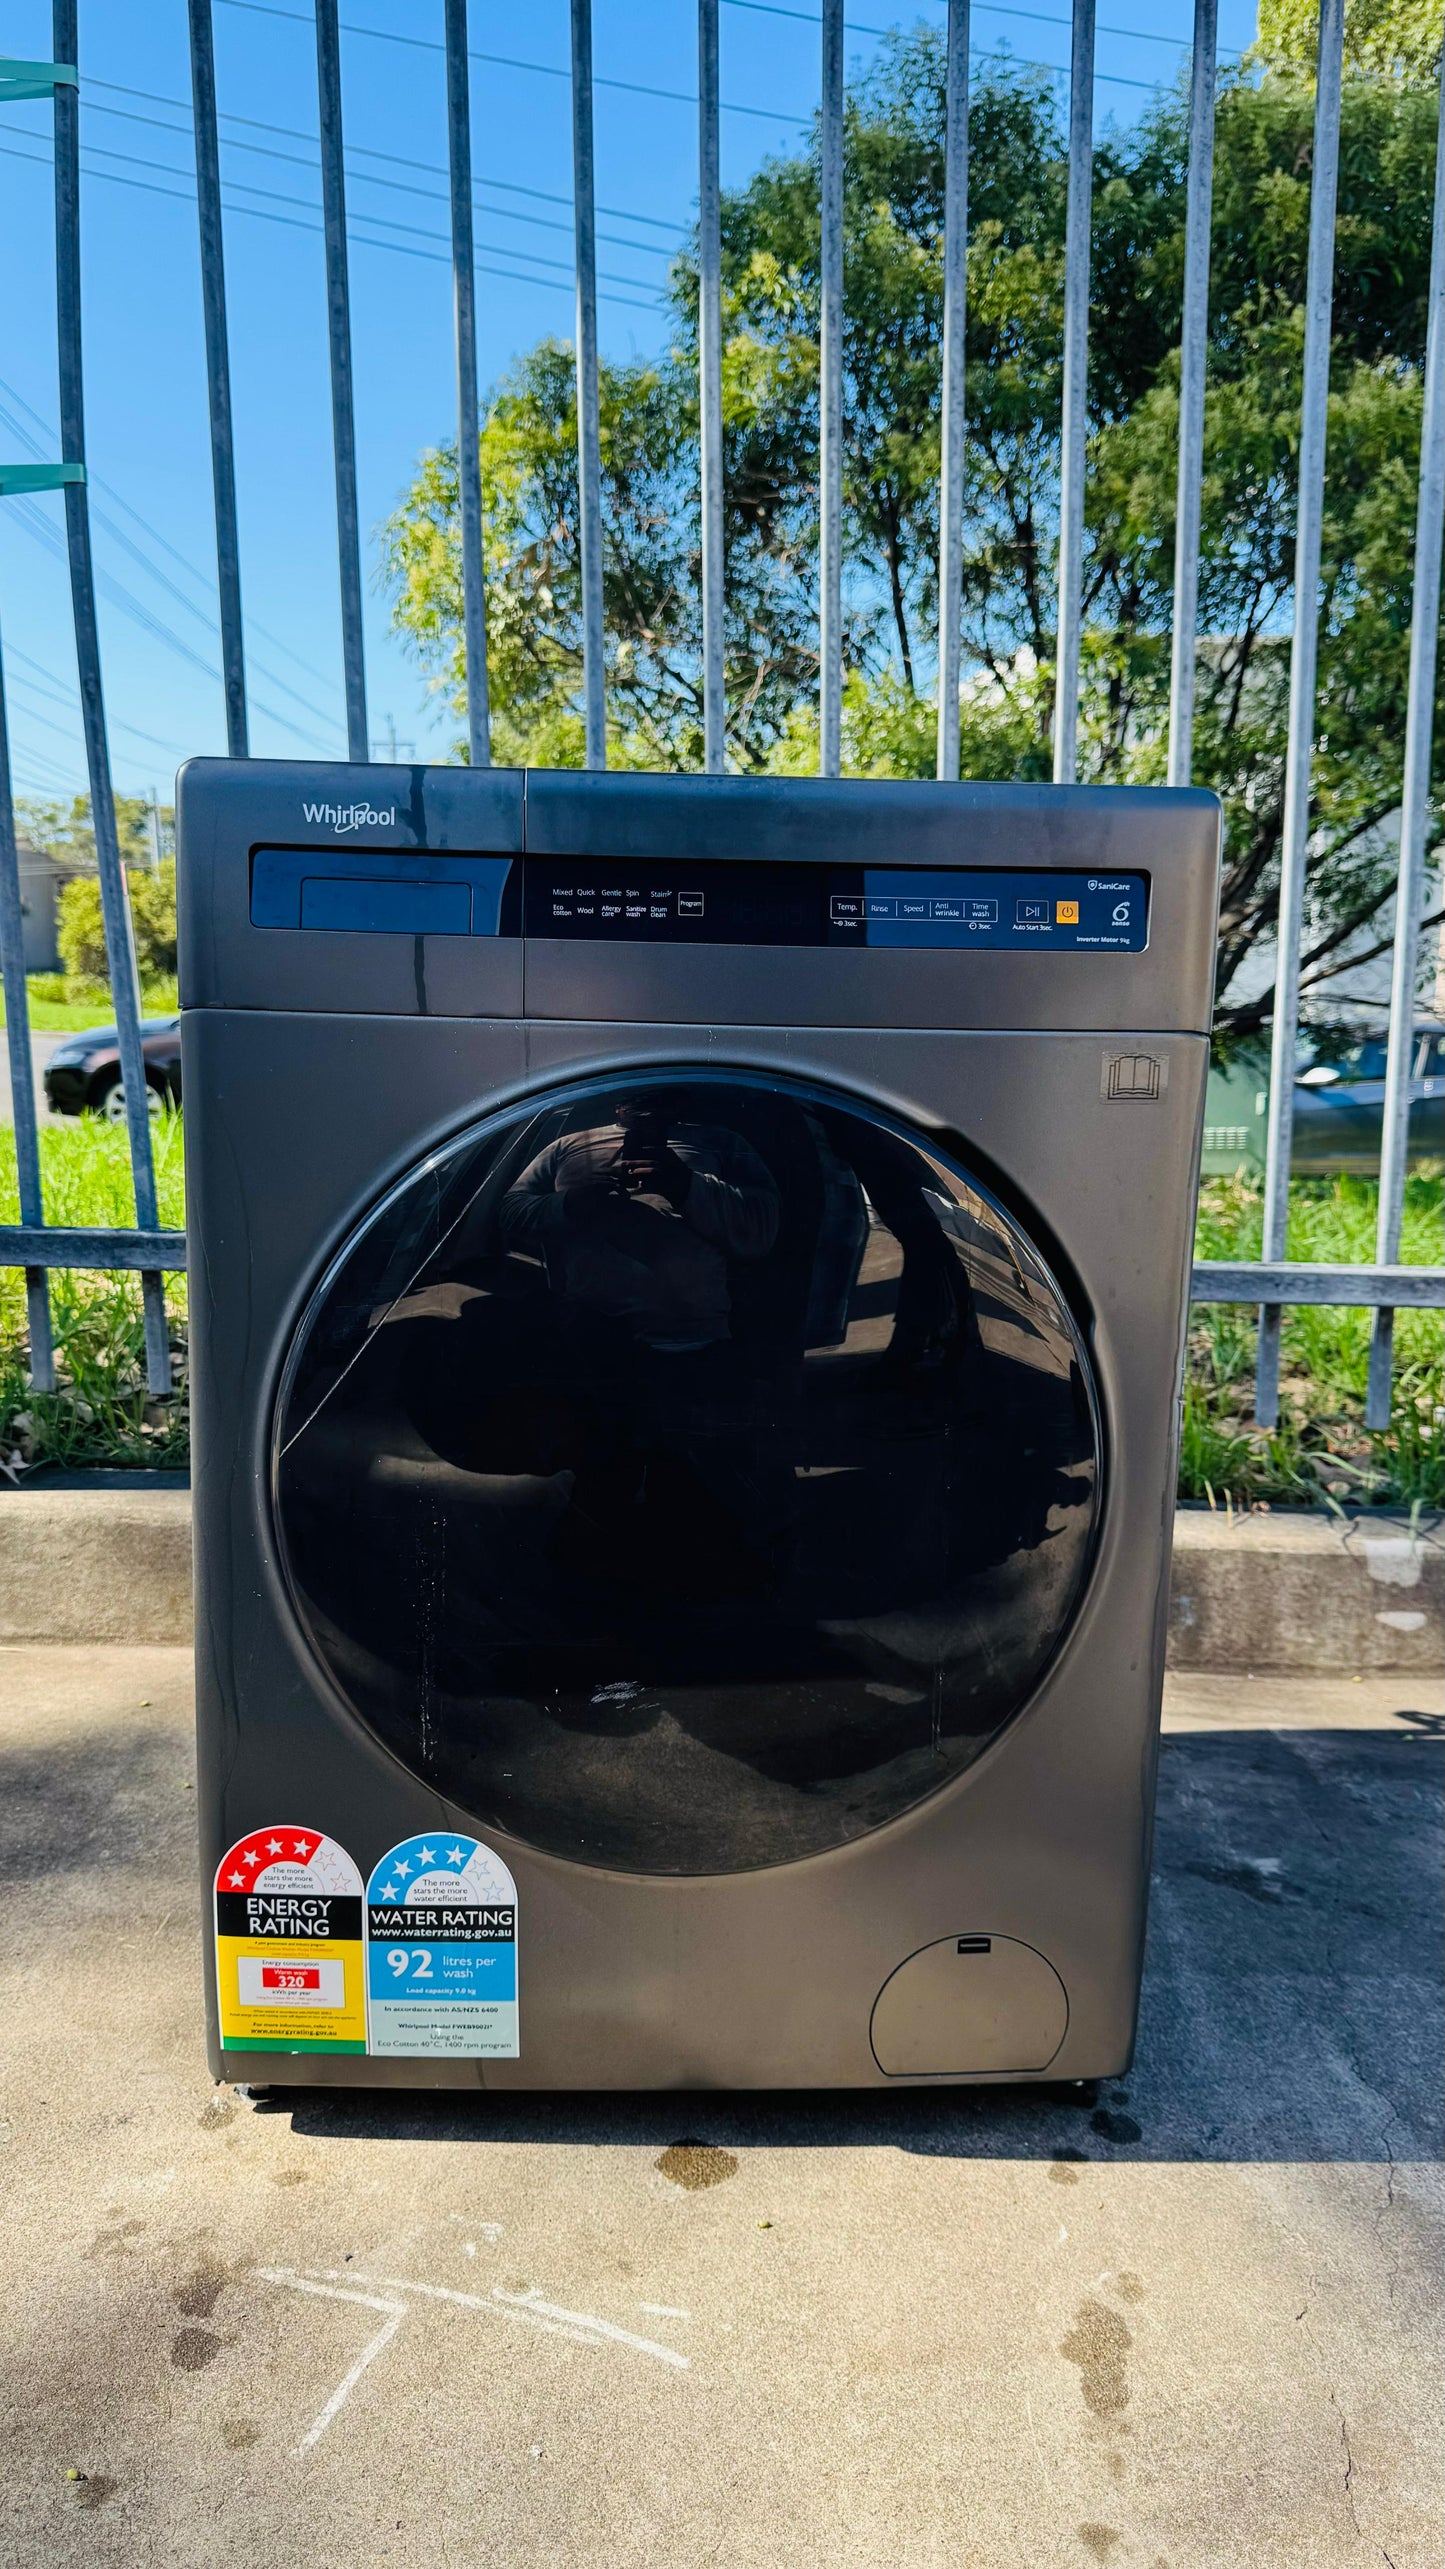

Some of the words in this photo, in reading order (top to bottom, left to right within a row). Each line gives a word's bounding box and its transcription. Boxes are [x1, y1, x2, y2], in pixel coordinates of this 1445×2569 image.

[303, 803, 395, 833] Whirlpool
[837, 903, 857, 911] Temp.
[904, 905, 923, 913] Speed
[247, 1898, 332, 1917] ENERGY
[371, 1910, 438, 1925] WATER
[442, 1911, 512, 1926] RATING
[250, 1917, 330, 1936] RATING
[372, 1927, 512, 1939] www.waterrating.gov.au
[387, 1949, 434, 1978] 92
[443, 1956, 472, 1966] litres
[476, 1958, 496, 1969] per
[443, 1968, 473, 1978] wash
[278, 1976, 305, 1988] 320
